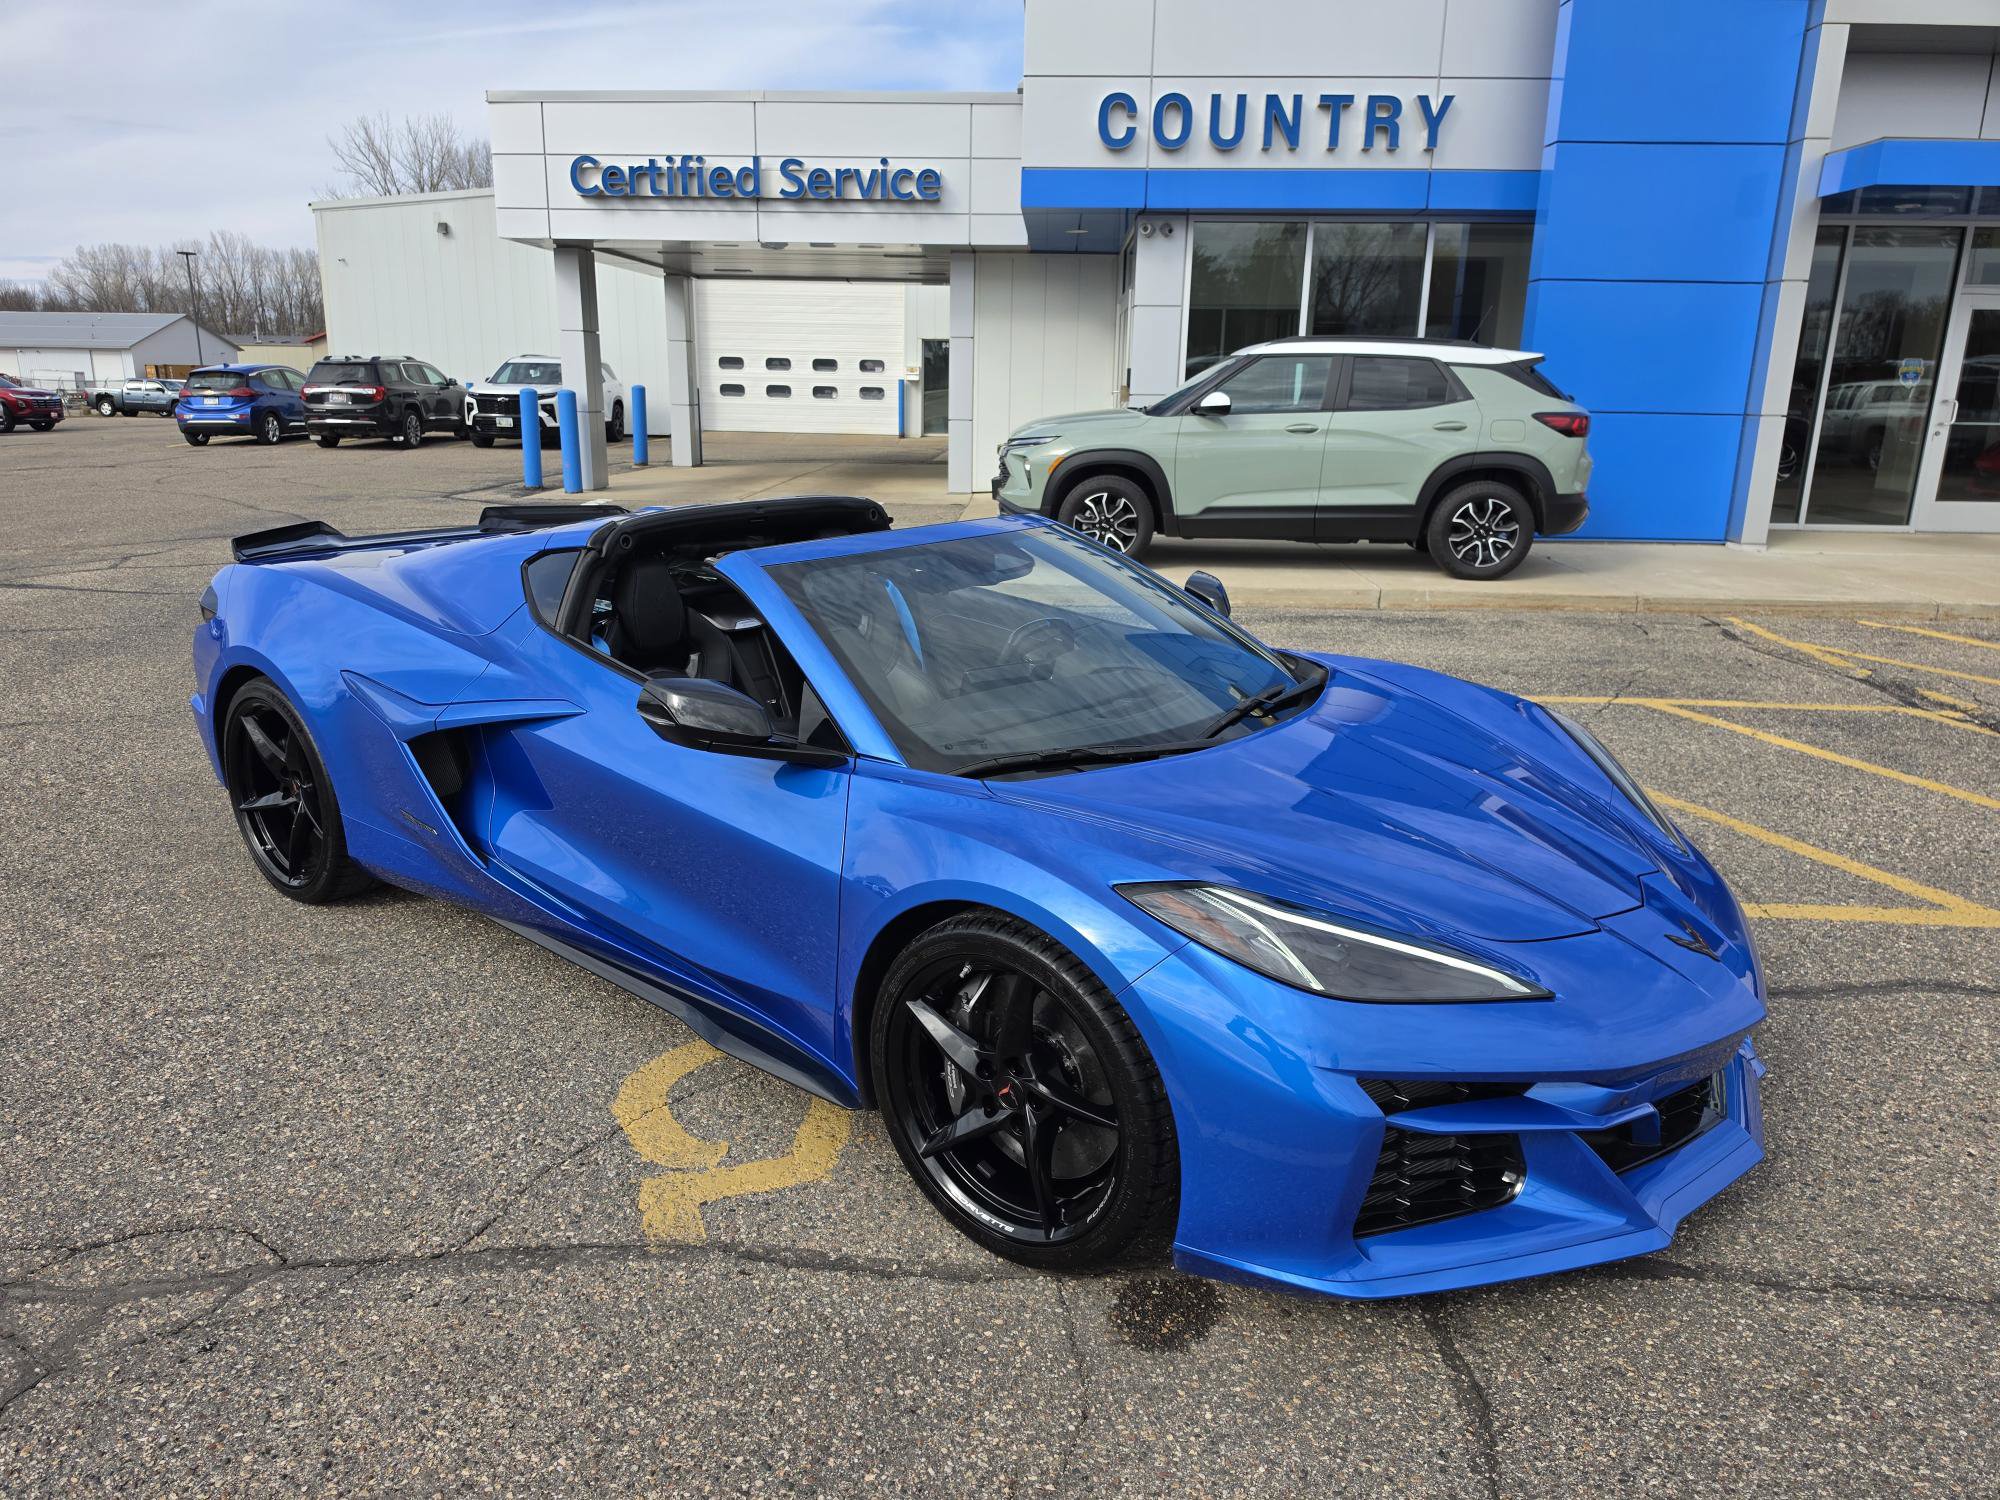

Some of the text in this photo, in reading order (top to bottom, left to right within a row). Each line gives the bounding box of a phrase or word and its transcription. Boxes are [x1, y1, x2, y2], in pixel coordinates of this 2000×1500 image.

[1097, 92, 1456, 151] COUNTRY
[570, 154, 943, 200] Certified Service
